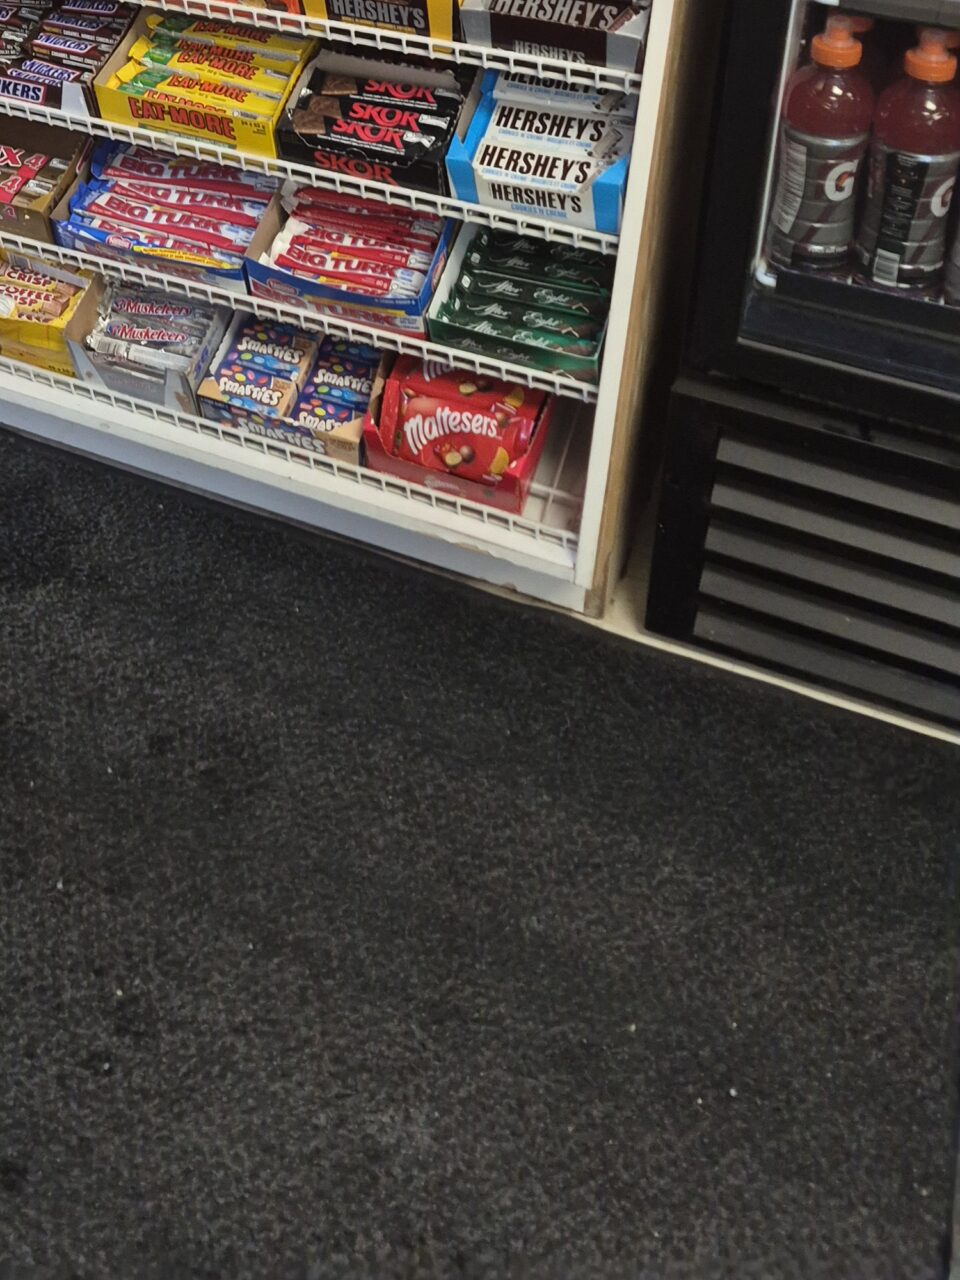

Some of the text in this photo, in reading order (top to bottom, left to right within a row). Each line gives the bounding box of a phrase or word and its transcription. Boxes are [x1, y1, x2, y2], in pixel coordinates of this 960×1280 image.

[177, 51, 259, 81] EAT-MORE
[168, 74, 250, 103] EAT-MORE
[128, 98, 236, 141] EAT-MORE
[349, 102, 421, 132] SKOR
[496, 105, 606, 143] HERSHEY'S
[333, 118, 404, 150] SKOR
[120, 157, 164, 177] BIG
[314, 150, 399, 187] SKOR
[480, 144, 592, 184] HERSHEY'S
[2, 176, 20, 194] 4
[491, 183, 583, 213] HERSHEY'S
[105, 195, 224, 233] BIG TURK
[7, 271, 53, 287] CRISP
[287, 245, 396, 283] BIG TURK
[120, 323, 189, 343] Musketeers
[404, 405, 500, 457] Maltesers
